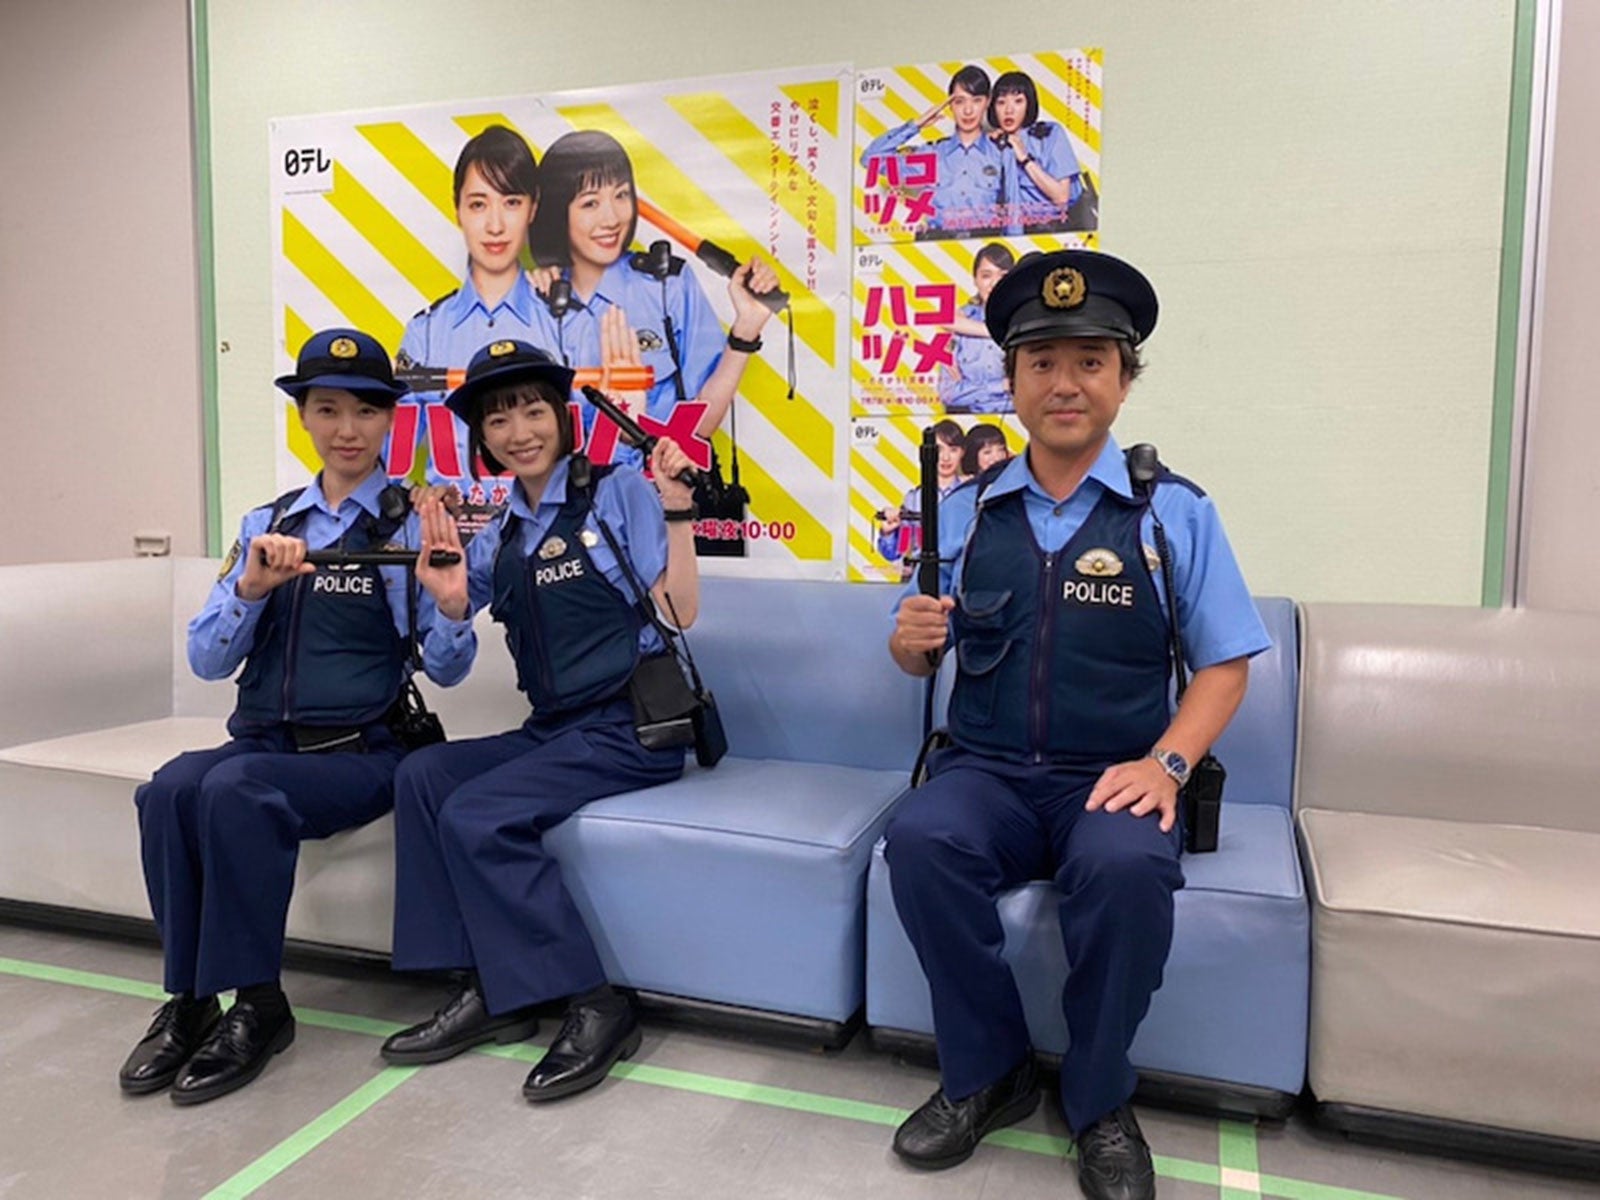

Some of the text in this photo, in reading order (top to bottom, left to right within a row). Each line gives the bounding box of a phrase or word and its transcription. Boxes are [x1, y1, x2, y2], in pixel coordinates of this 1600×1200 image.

[861, 79, 885, 93] 日テレ
[788, 101, 800, 192] やけにリアルな
[284, 148, 331, 177] 日テレ
[865, 153, 937, 188] ハコ
[864, 188, 936, 225] ヅメ
[859, 255, 883, 267] 日テレ
[863, 284, 956, 327] ハコ
[862, 330, 954, 374] ヅメ
[855, 426, 878, 438] 日テレ
[313, 575, 373, 595] POLICE
[535, 559, 584, 586] POLICE
[1063, 581, 1133, 606] POLICE
